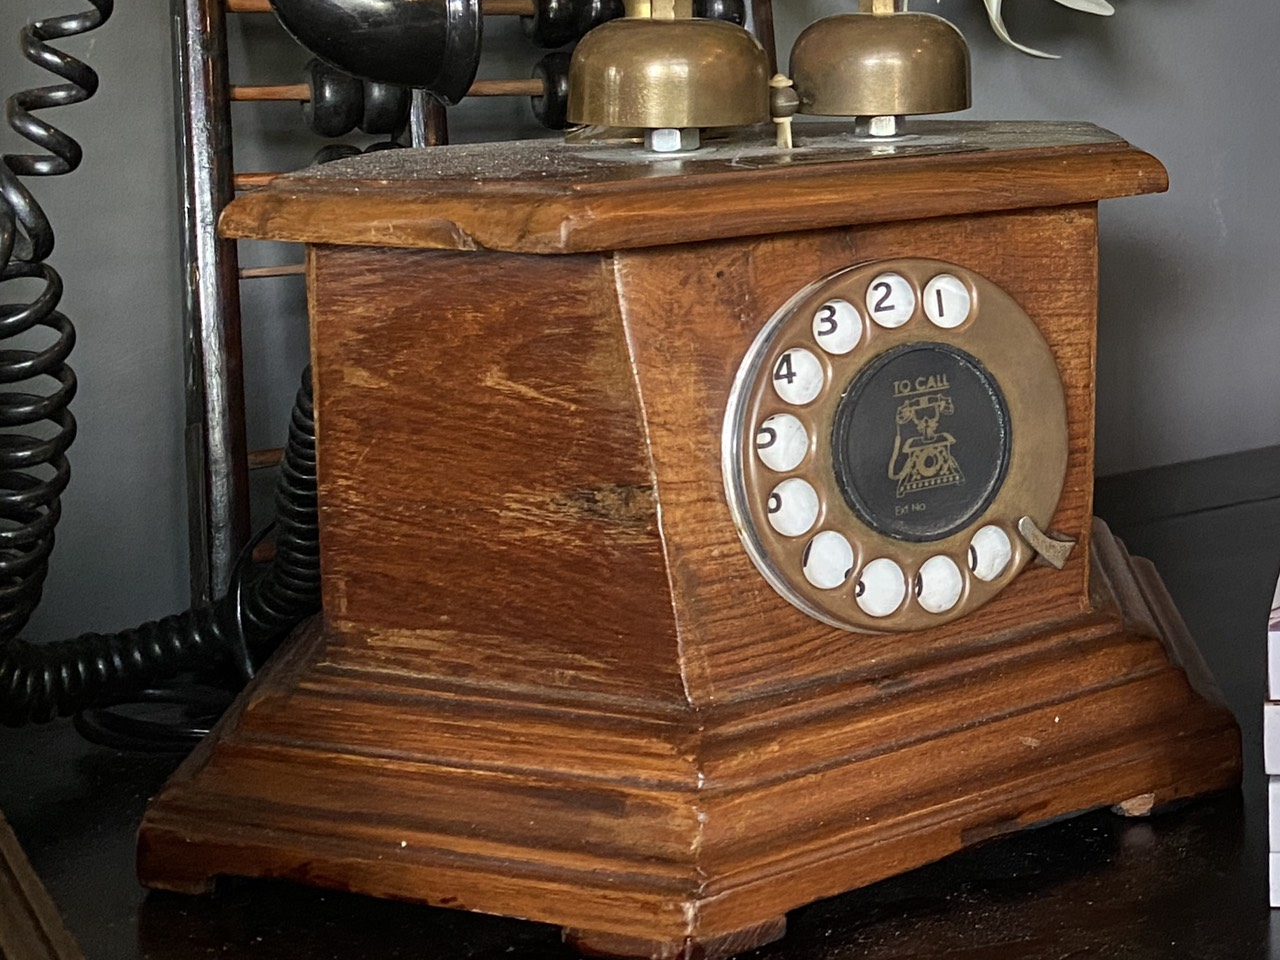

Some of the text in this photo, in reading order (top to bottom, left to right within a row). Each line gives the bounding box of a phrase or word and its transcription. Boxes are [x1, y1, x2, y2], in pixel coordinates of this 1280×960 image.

[872, 282, 895, 313] 2
[935, 289, 944, 317] 1
[817, 305, 839, 336] 3
[773, 354, 796, 384] 4
[894, 374, 949, 394] TO CALL
